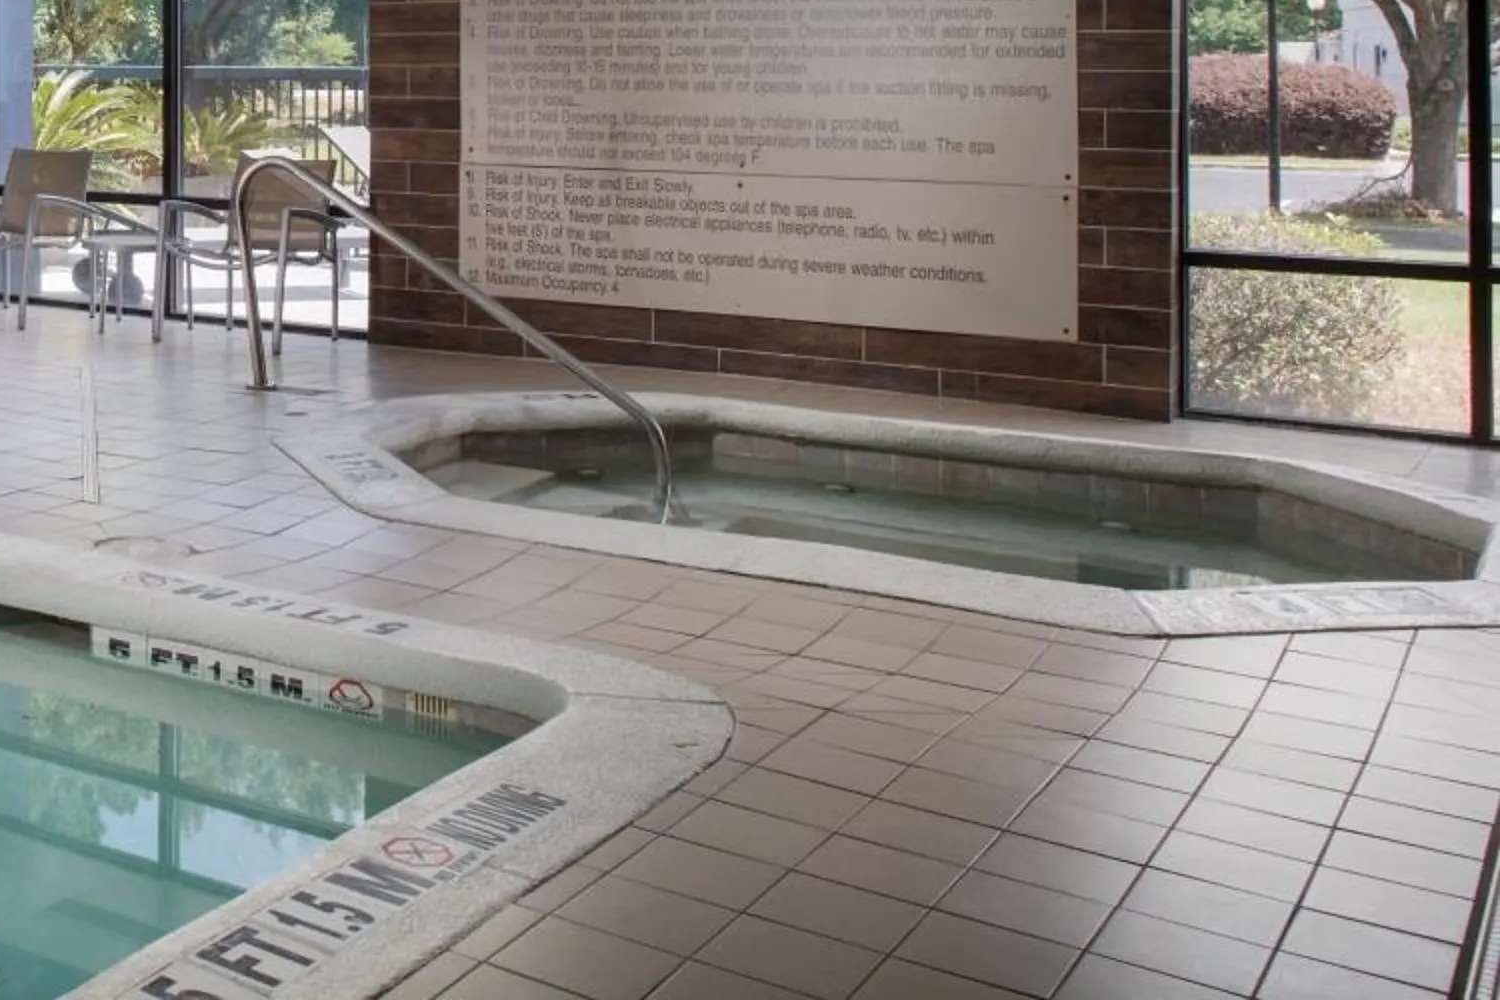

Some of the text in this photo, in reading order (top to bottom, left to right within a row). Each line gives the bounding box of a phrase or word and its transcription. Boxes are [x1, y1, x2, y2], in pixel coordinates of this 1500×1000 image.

[985, 27, 1016, 43] may
[1021, 26, 1067, 39] cause
[996, 43, 1065, 58] extended
[934, 136, 964, 153] The
[968, 140, 997, 156] spa
[486, 170, 509, 185] Risk
[511, 172, 523, 185] of
[563, 173, 594, 189] Enter
[599, 176, 621, 190] and
[626, 177, 649, 191] Exit
[564, 192, 595, 207] Keep
[615, 194, 676, 210] breakable
[679, 199, 725, 215] objects
[729, 201, 750, 214] out
[753, 200, 767, 214] of
[770, 201, 791, 216] the
[795, 204, 819, 218] spa
[551, 224, 563, 239] of
[566, 226, 585, 240] the
[568, 209, 604, 223] Never
[607, 211, 641, 227] place
[703, 216, 772, 232] appliances
[853, 224, 891, 242] radio,
[917, 227, 948, 246] etc.)
[951, 228, 997, 245] within
[569, 242, 593, 258] The
[595, 246, 618, 260] spa
[622, 246, 650, 261] shall
[654, 250, 675, 262] not
[678, 251, 694, 264] be
[698, 253, 754, 270] operated
[757, 255, 799, 274] during
[802, 260, 847, 274] severe
[851, 263, 906, 279] weather
[909, 266, 987, 283] conditions.
[486, 270, 619, 292] Maximum 4
[364, 621, 410, 635] 5
[209, 661, 255, 689] 1.5
[425, 783, 567, 851] NO DIVING
[195, 925, 316, 988] FT
[268, 892, 376, 941] 1.5
[324, 858, 438, 907] M
